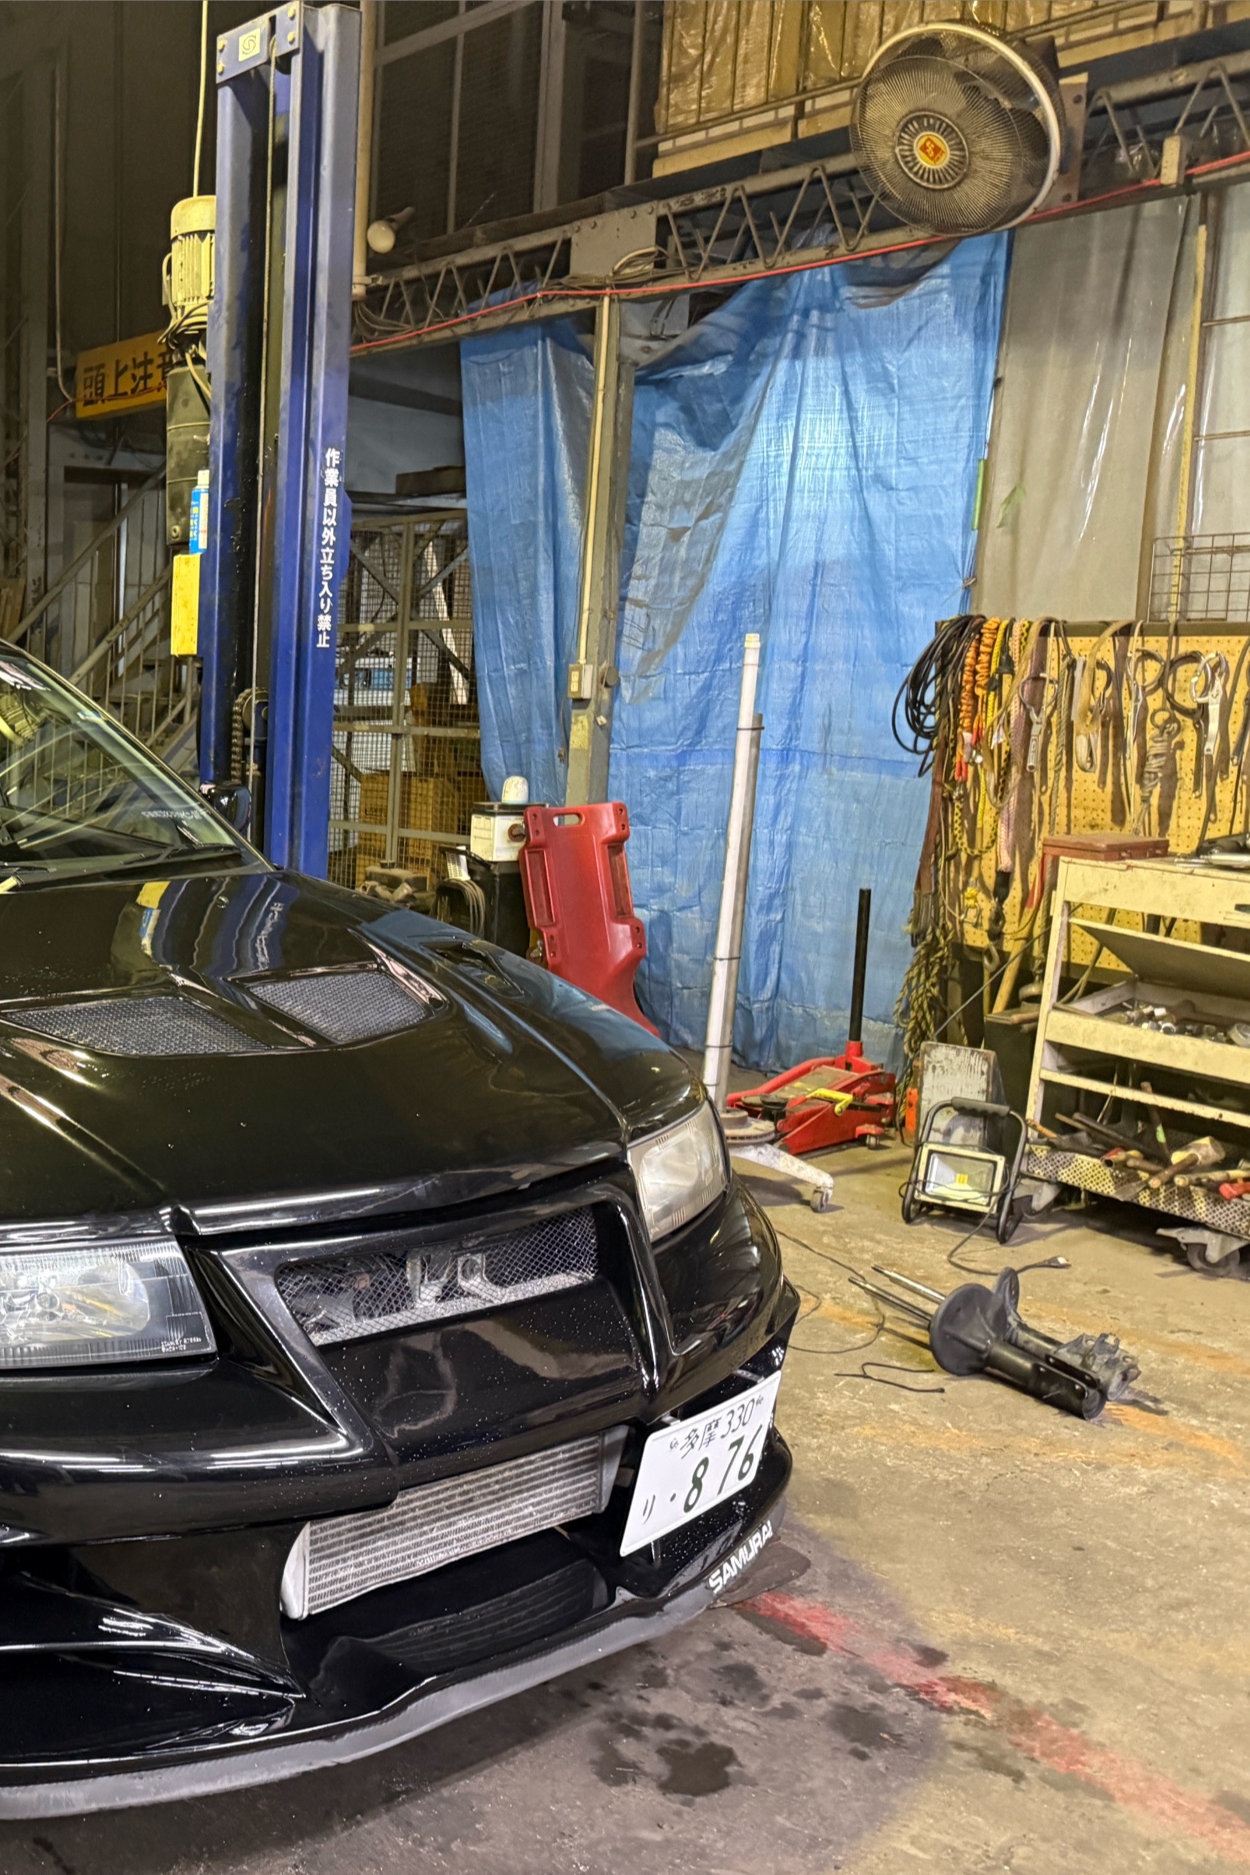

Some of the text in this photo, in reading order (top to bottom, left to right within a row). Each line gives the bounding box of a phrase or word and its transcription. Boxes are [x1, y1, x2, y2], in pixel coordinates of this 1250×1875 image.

[316, 448, 342, 648] 作業員以外立ち入り禁止
[679, 1399, 755, 1460] 多摩 330
[708, 1520, 773, 1594] SAMURAI
